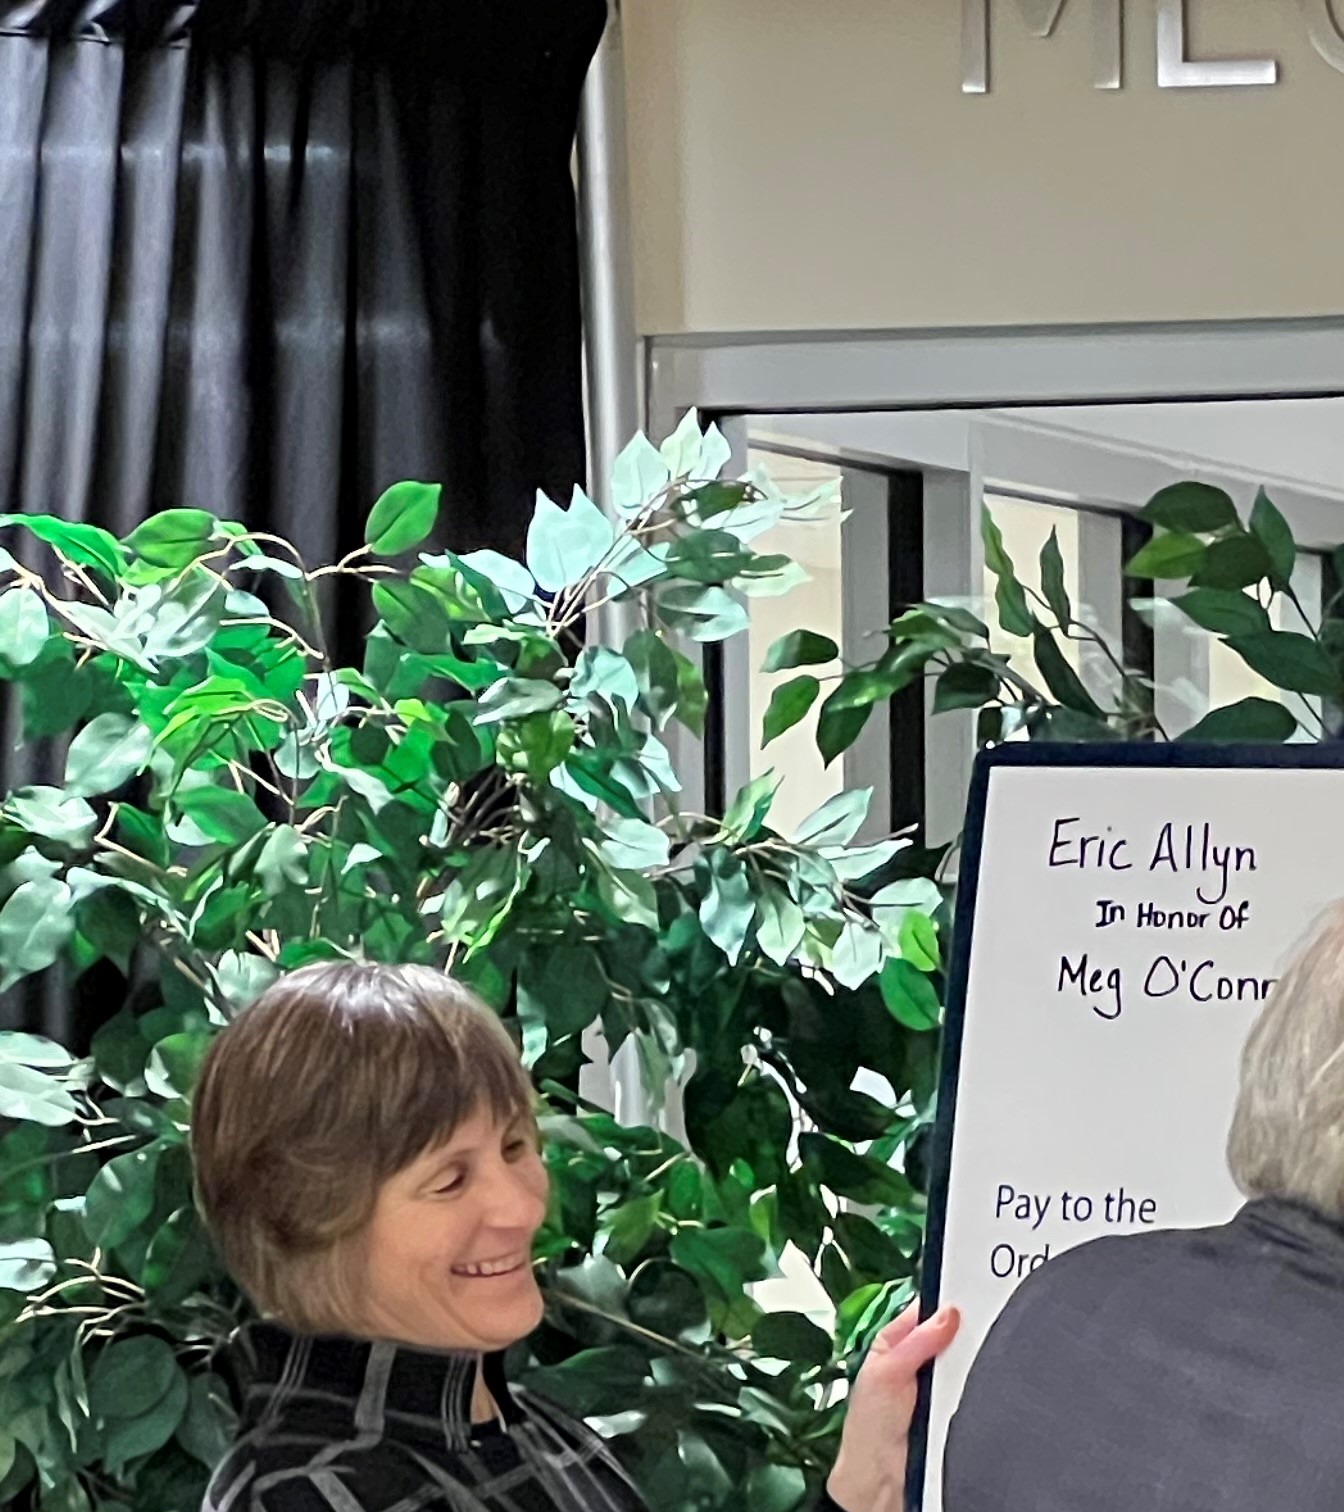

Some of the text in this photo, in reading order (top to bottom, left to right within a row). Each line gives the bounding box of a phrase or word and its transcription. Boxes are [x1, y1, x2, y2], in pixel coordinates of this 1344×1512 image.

[1049, 817, 1257, 904] Eric Allyn
[1095, 900, 1250, 931] In Honor Of
[1058, 953, 1122, 1020] Meg
[995, 1184, 1157, 1231] Pay to the
